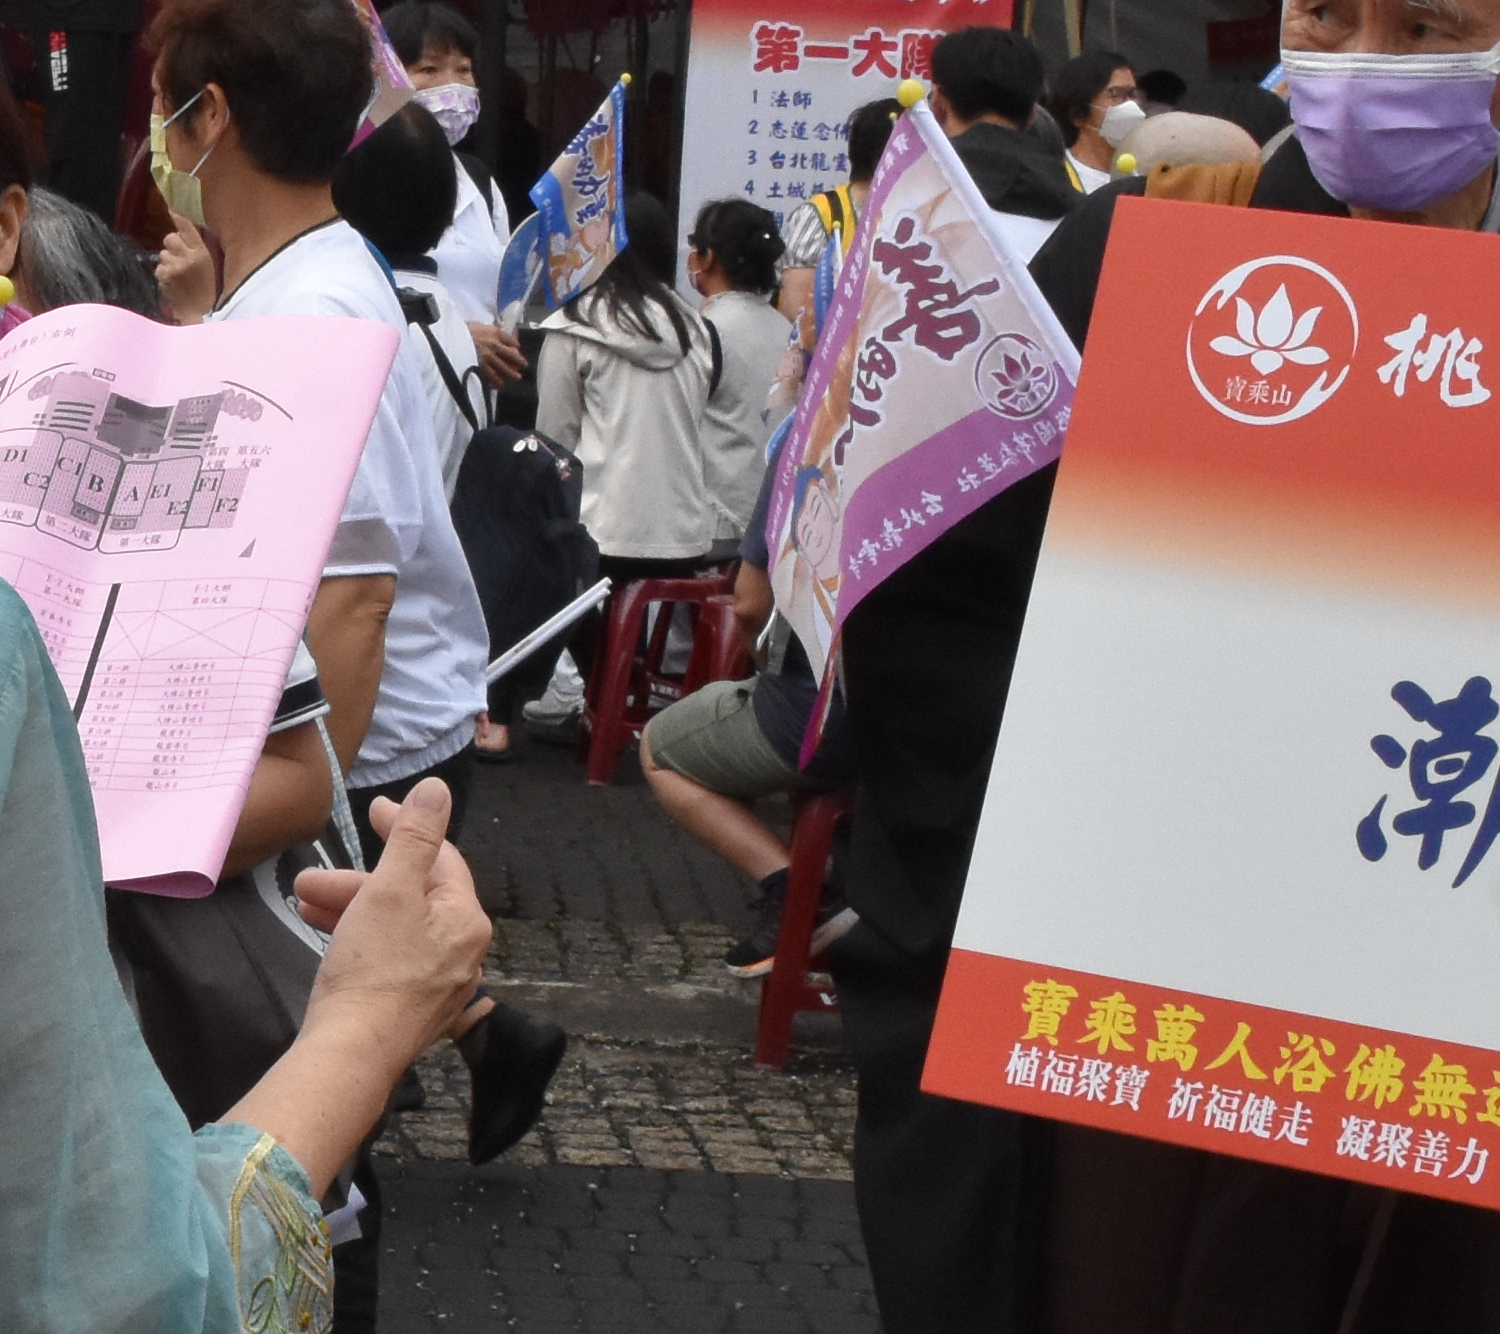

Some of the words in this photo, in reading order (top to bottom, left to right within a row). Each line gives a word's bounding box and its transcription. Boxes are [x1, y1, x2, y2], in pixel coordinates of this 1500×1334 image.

[770, 90, 813, 110] 法師
[748, 120, 759, 135] 2
[747, 150, 758, 166] 3
[744, 180, 755, 196] 4
[1222, 371, 1293, 408] 寶乘山
[3, 447, 29, 464] D1
[57, 456, 84, 478] C1
[22, 472, 51, 490] C2
[87, 473, 104, 494] B
[124, 484, 141, 504] A
[149, 483, 173, 500] E1
[214, 497, 240, 514] F2
[1005, 1042, 1151, 1112] 植福聚寶
[1166, 1077, 1315, 1147] 祈福健走
[1335, 1115, 1490, 1185] 凝聚善力
